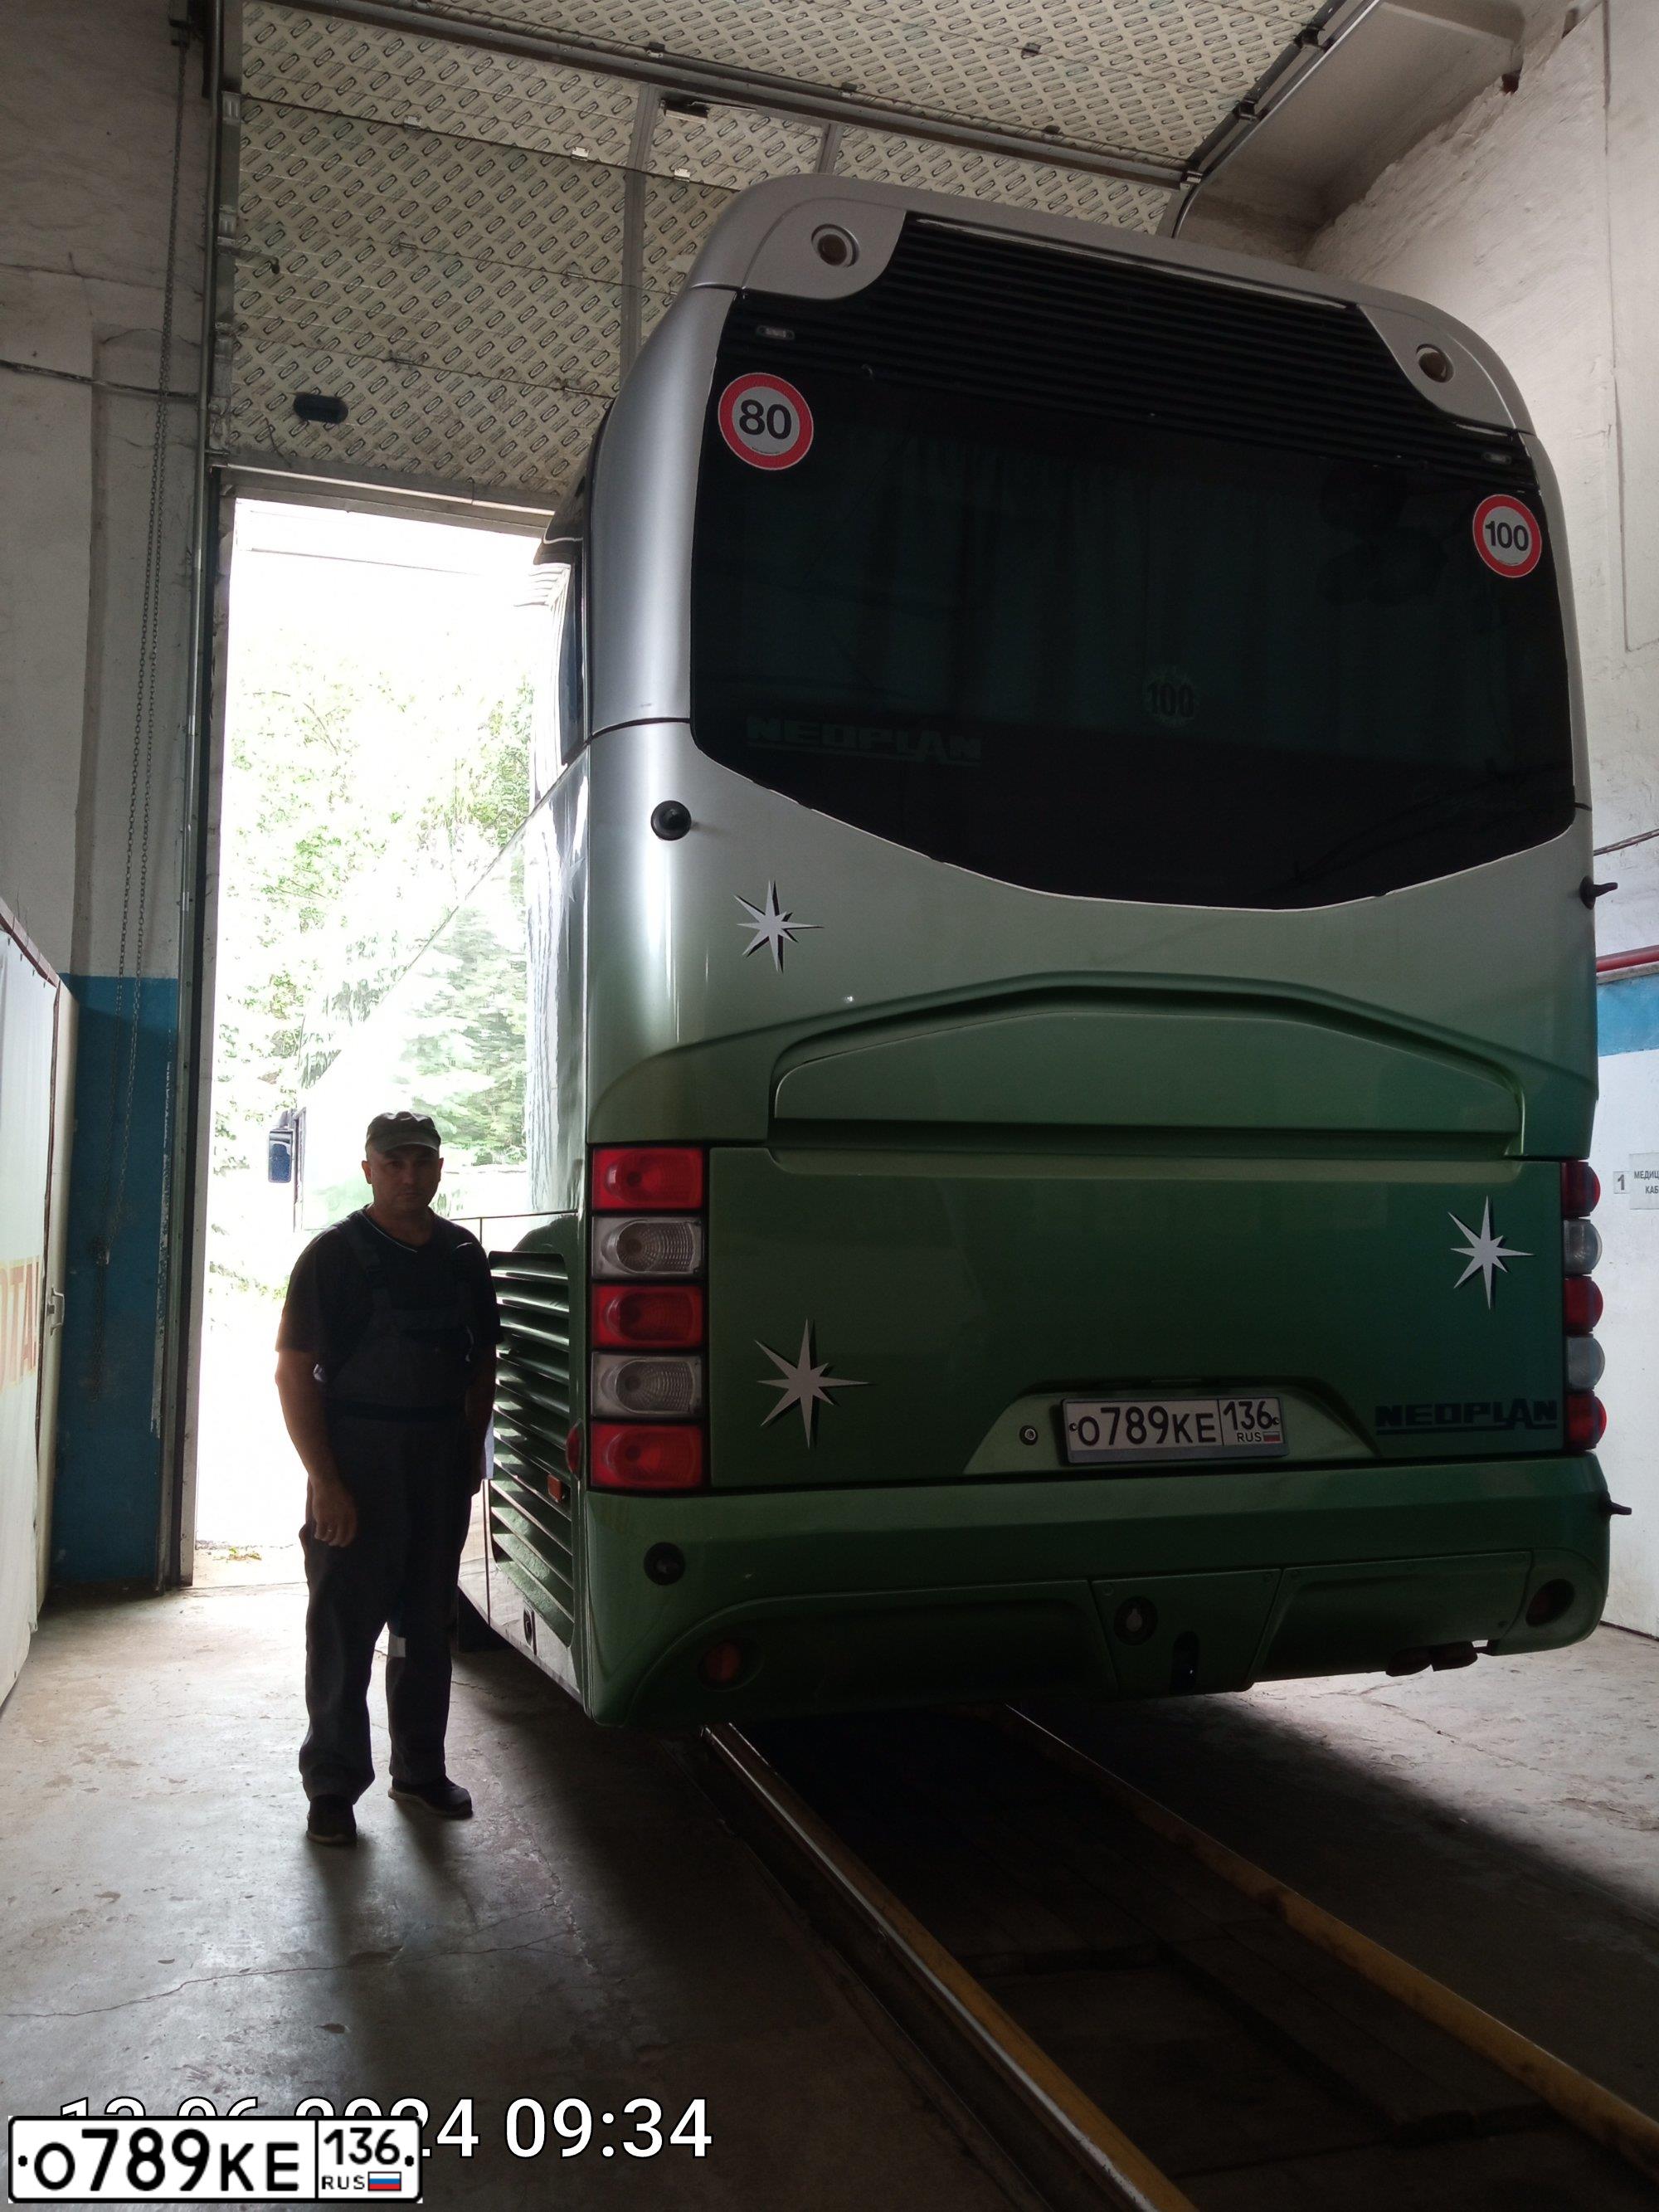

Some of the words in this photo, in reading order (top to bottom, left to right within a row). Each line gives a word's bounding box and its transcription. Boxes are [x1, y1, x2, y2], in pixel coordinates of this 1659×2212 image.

[740, 399, 791, 440] 80
[1485, 521, 1529, 551] 100
[1148, 683, 1194, 718] 100
[747, 717, 982, 765] NEOPLAN
[1618, 1174, 1625, 1191] 1
[1224, 1401, 1272, 1430] 136
[1375, 1399, 1558, 1434] NEOPLAN
[1237, 1432, 1262, 1442] RUS
